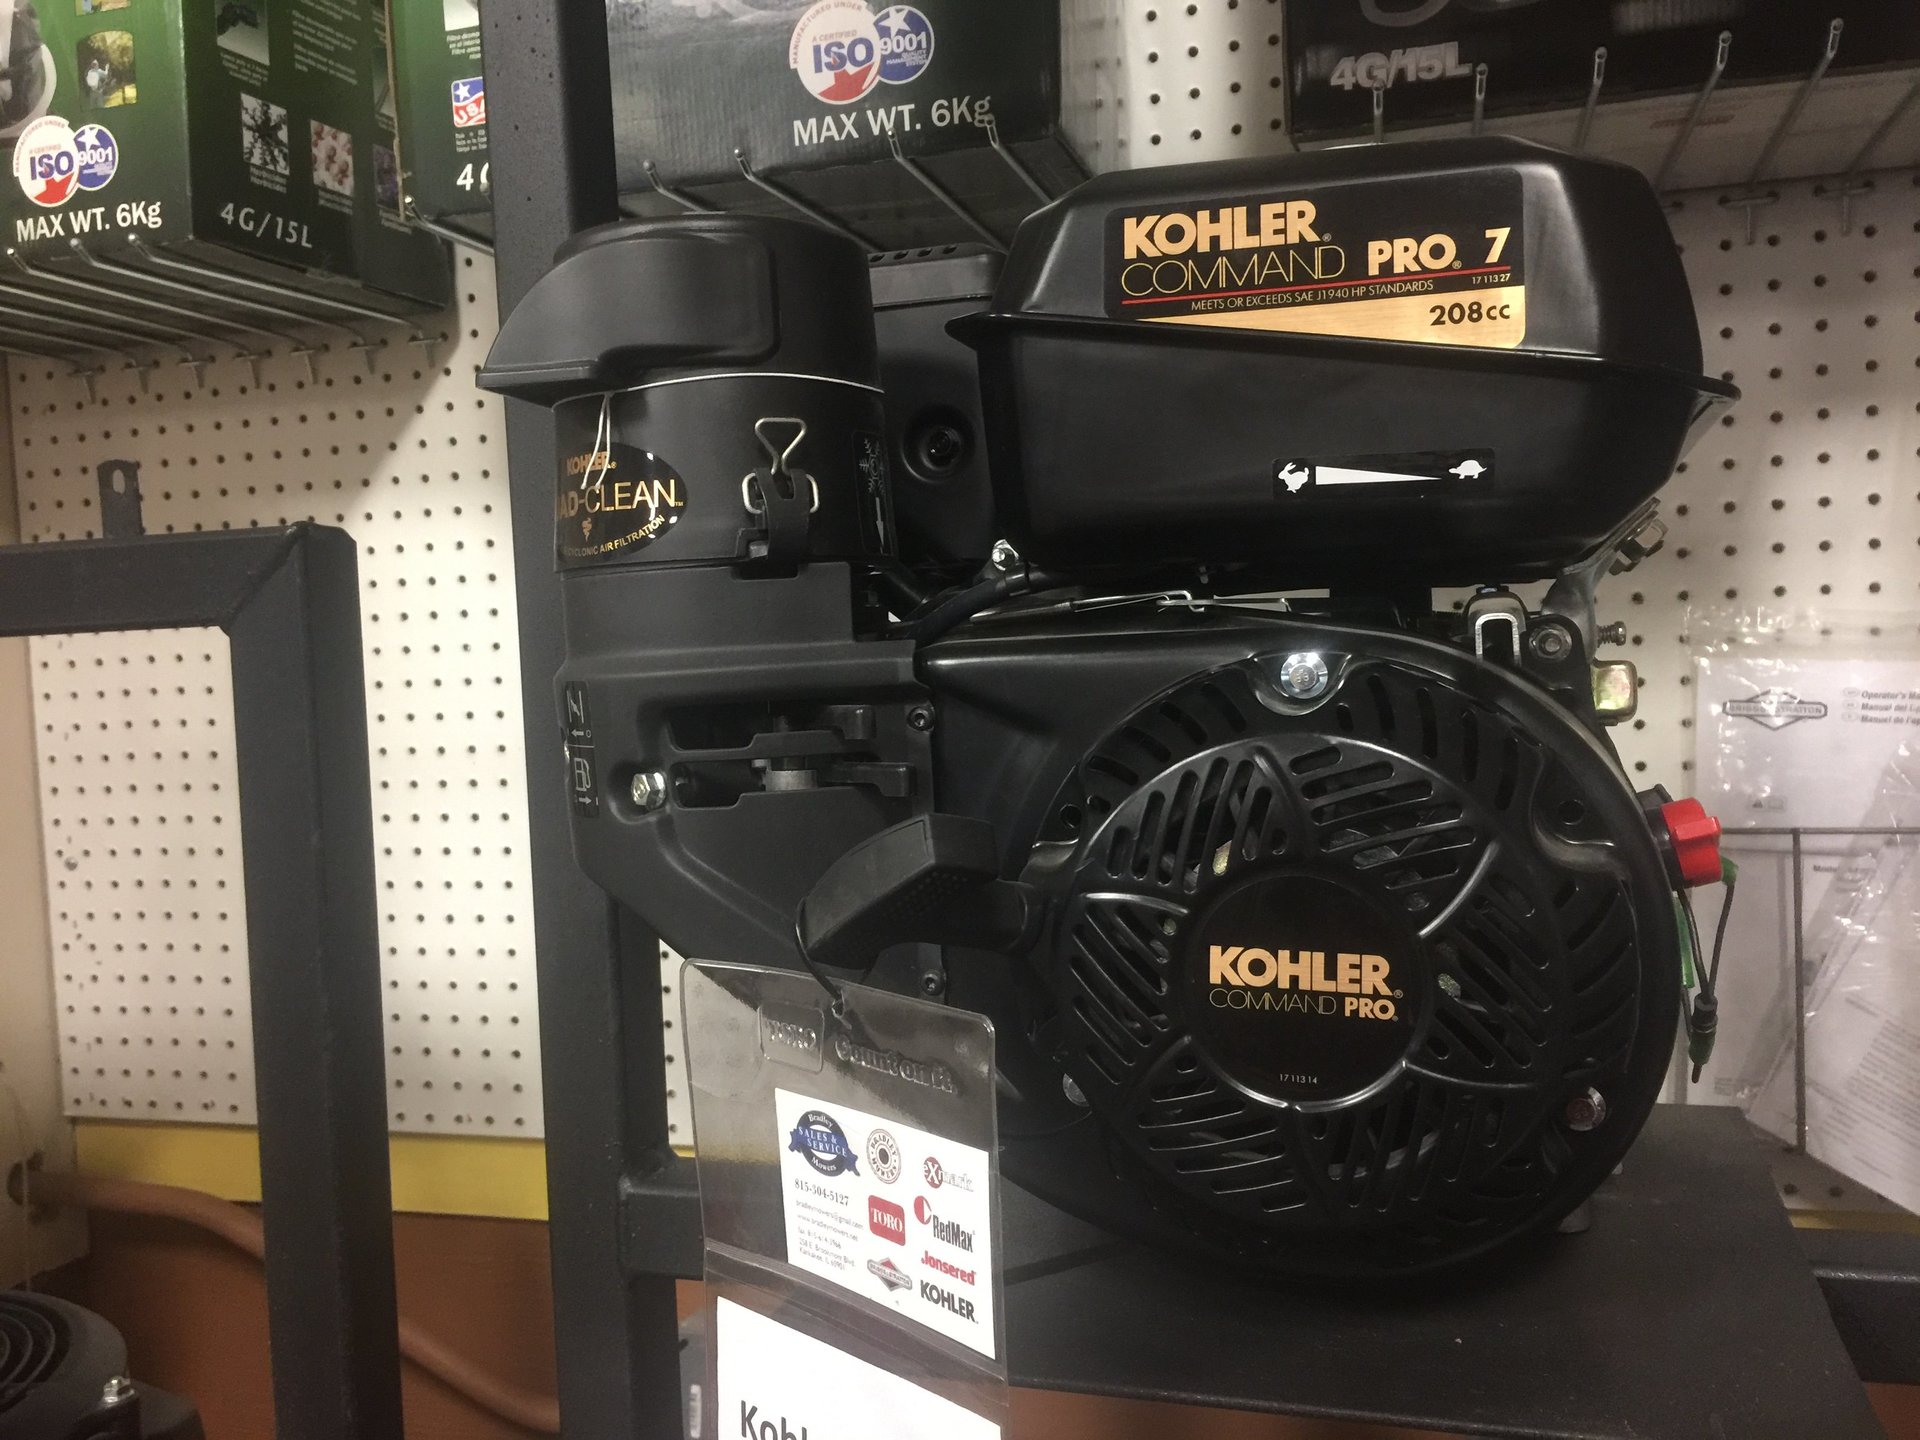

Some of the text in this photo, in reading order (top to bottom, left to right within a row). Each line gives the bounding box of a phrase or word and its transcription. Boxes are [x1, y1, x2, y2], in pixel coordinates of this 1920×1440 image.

[813, 31, 927, 74] ISO 9001
[1330, 41, 1473, 90] 4G/15L
[793, 95, 992, 147] MAX WT. 6Kg
[29, 151, 74, 181] ISO
[79, 147, 113, 167] 9001
[16, 201, 162, 243] MAX WT. 6Kg
[220, 202, 313, 249] 4G/15L
[1123, 199, 1321, 260] KOHLER
[1121, 226, 1511, 297] COMMAND PRO 7
[1191, 279, 1434, 311] MEETS OR EXCEEDS SAE J1940 HP STANDARDS
[1429, 301, 1511, 327] 208cc
[559, 479, 676, 518] AD-CLEAN
[600, 541, 614, 553] AIR
[614, 514, 666, 550] FILTRATION
[1209, 945, 1394, 996] KOHLER
[1209, 988, 1396, 1021] COMMAND PRO
[798, 1126, 837, 1144] SALES &
[808, 1113, 833, 1129] Bradley
[807, 1138, 848, 1157] SERVICE
[811, 1157, 837, 1171] Mowers
[794, 1179, 849, 1206] 815-304-5127
[870, 1208, 903, 1233] TORO
[933, 1214, 973, 1253] RedMax
[921, 1250, 976, 1286] Jonsered
[920, 1279, 976, 1323] KOHLER
